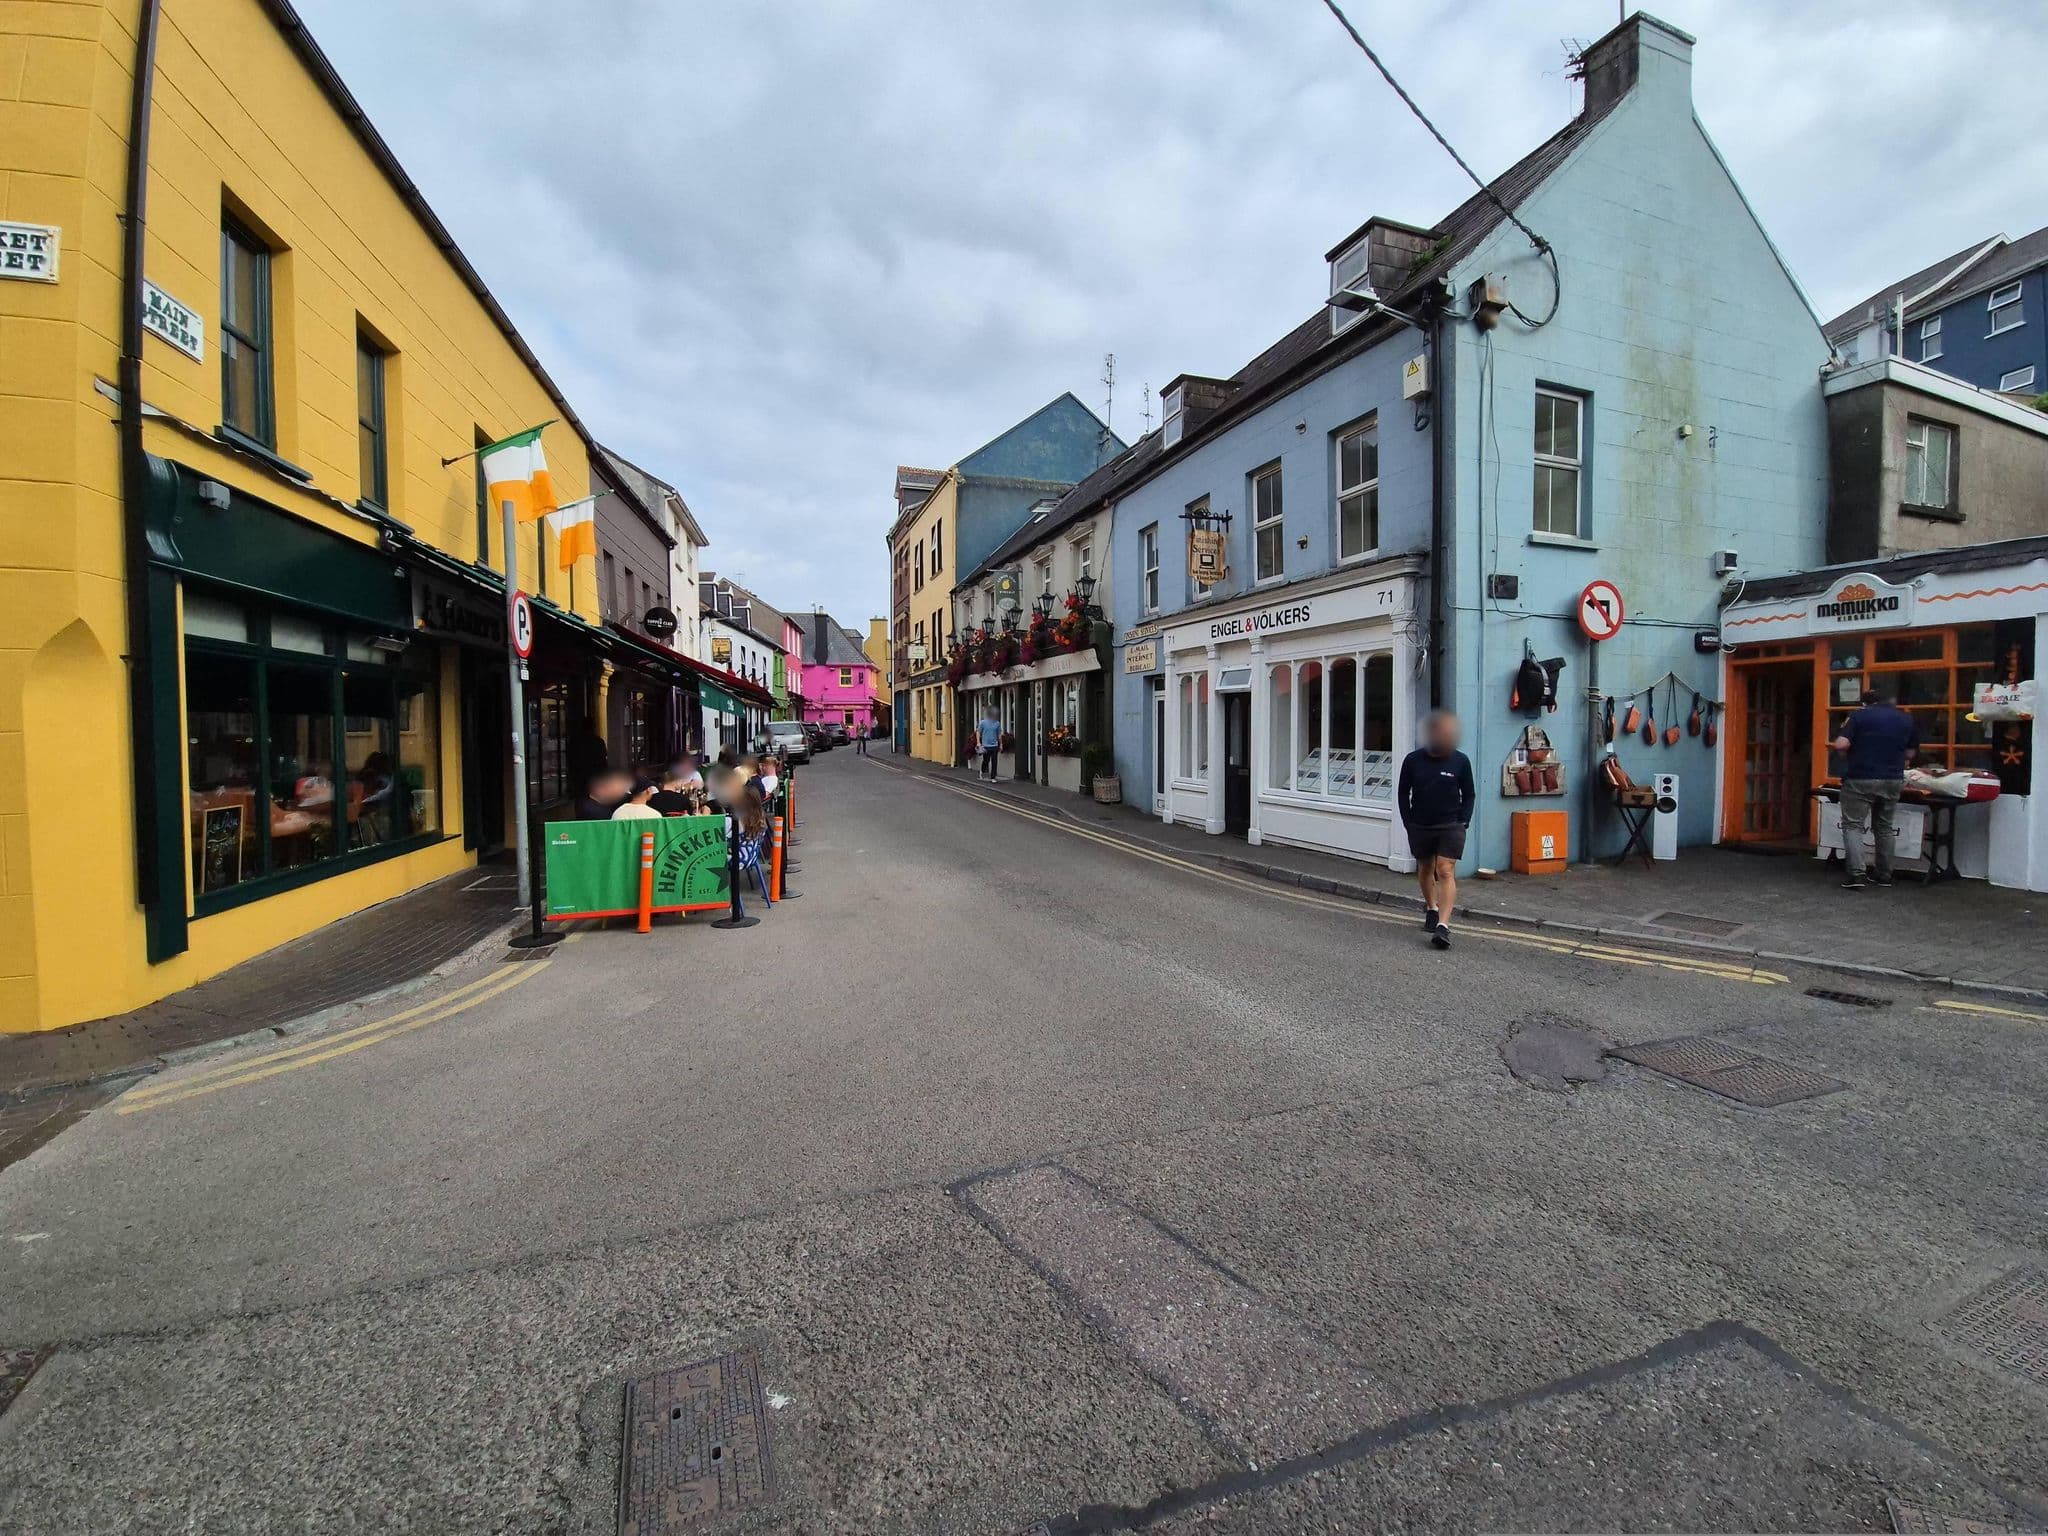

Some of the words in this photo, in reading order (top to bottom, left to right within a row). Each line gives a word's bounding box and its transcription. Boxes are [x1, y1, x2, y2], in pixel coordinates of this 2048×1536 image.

[150, 290, 188, 328] MAIN
[1378, 590, 1393, 605] 71
[1817, 596, 1899, 617] MAMUKKO
[658, 827, 727, 894] HEINEKEN
